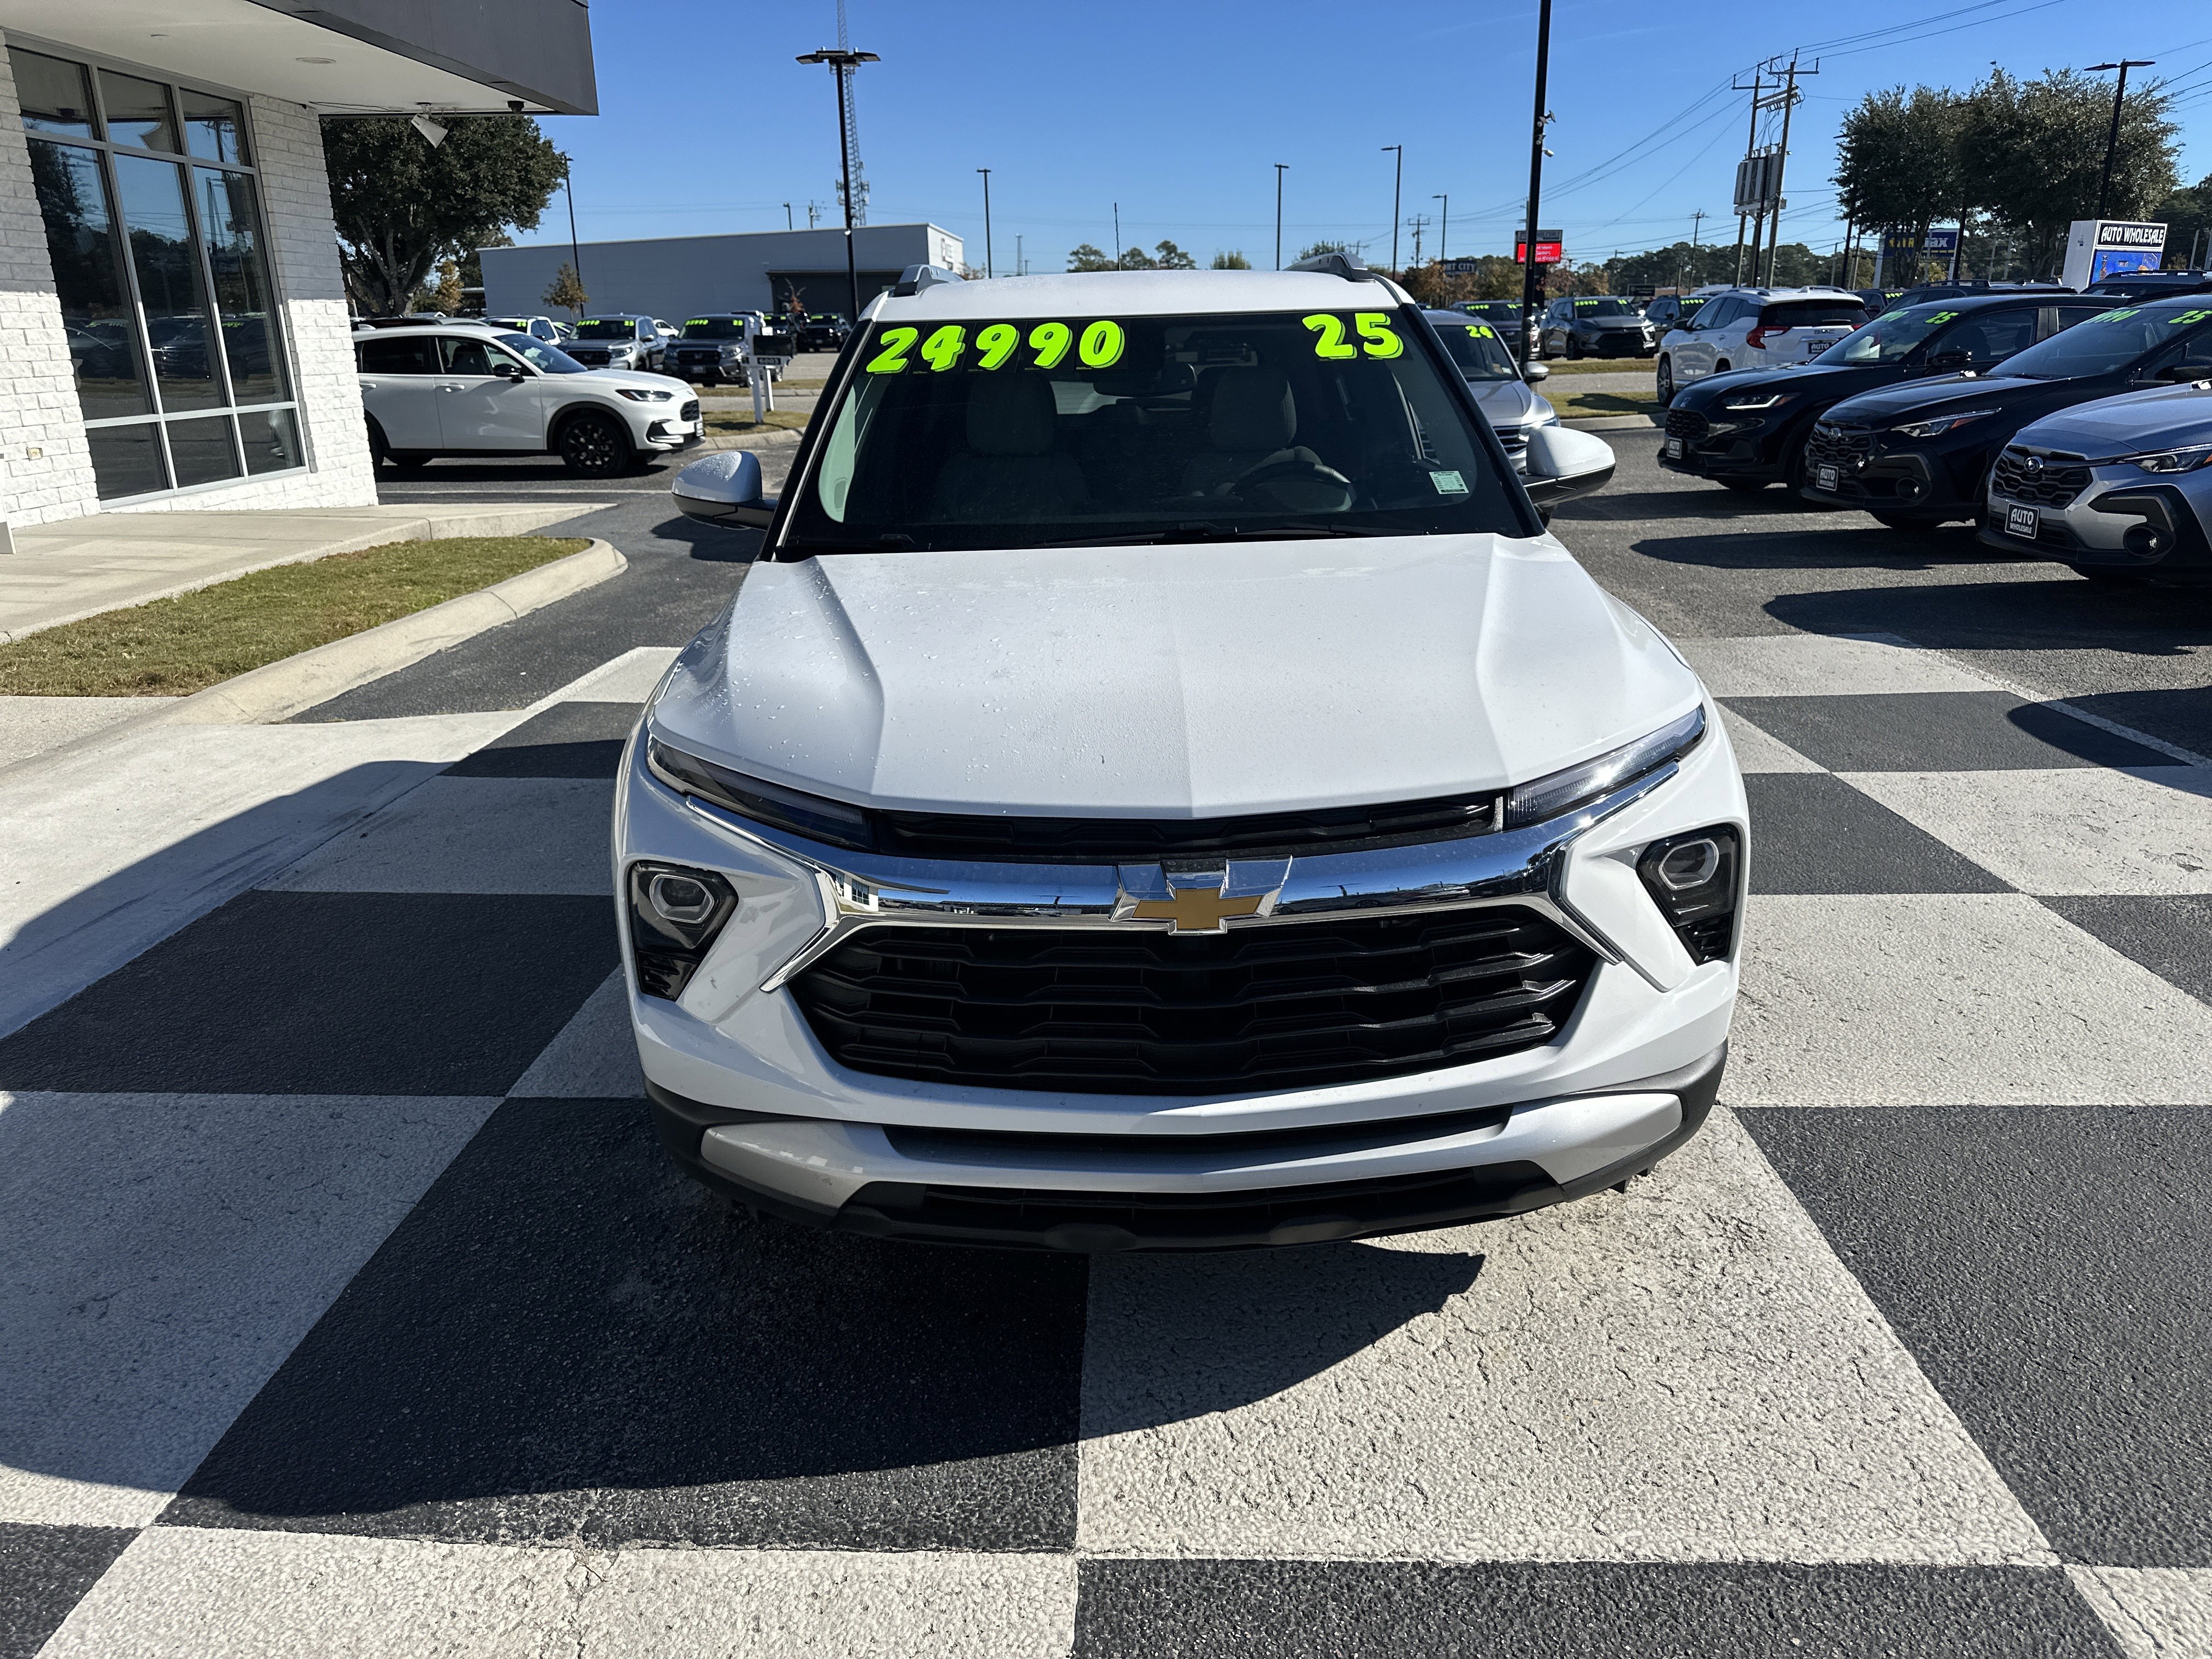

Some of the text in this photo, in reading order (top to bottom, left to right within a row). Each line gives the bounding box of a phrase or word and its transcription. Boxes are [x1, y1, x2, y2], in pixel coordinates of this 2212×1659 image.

[2101, 226, 2164, 244] AUTO WHOLESALE
[1925, 311, 1959, 324] 25
[866, 313, 1403, 374] 24990 25
[1820, 468, 1836, 481] AUTO
[2011, 508, 2034, 525] AUTO
